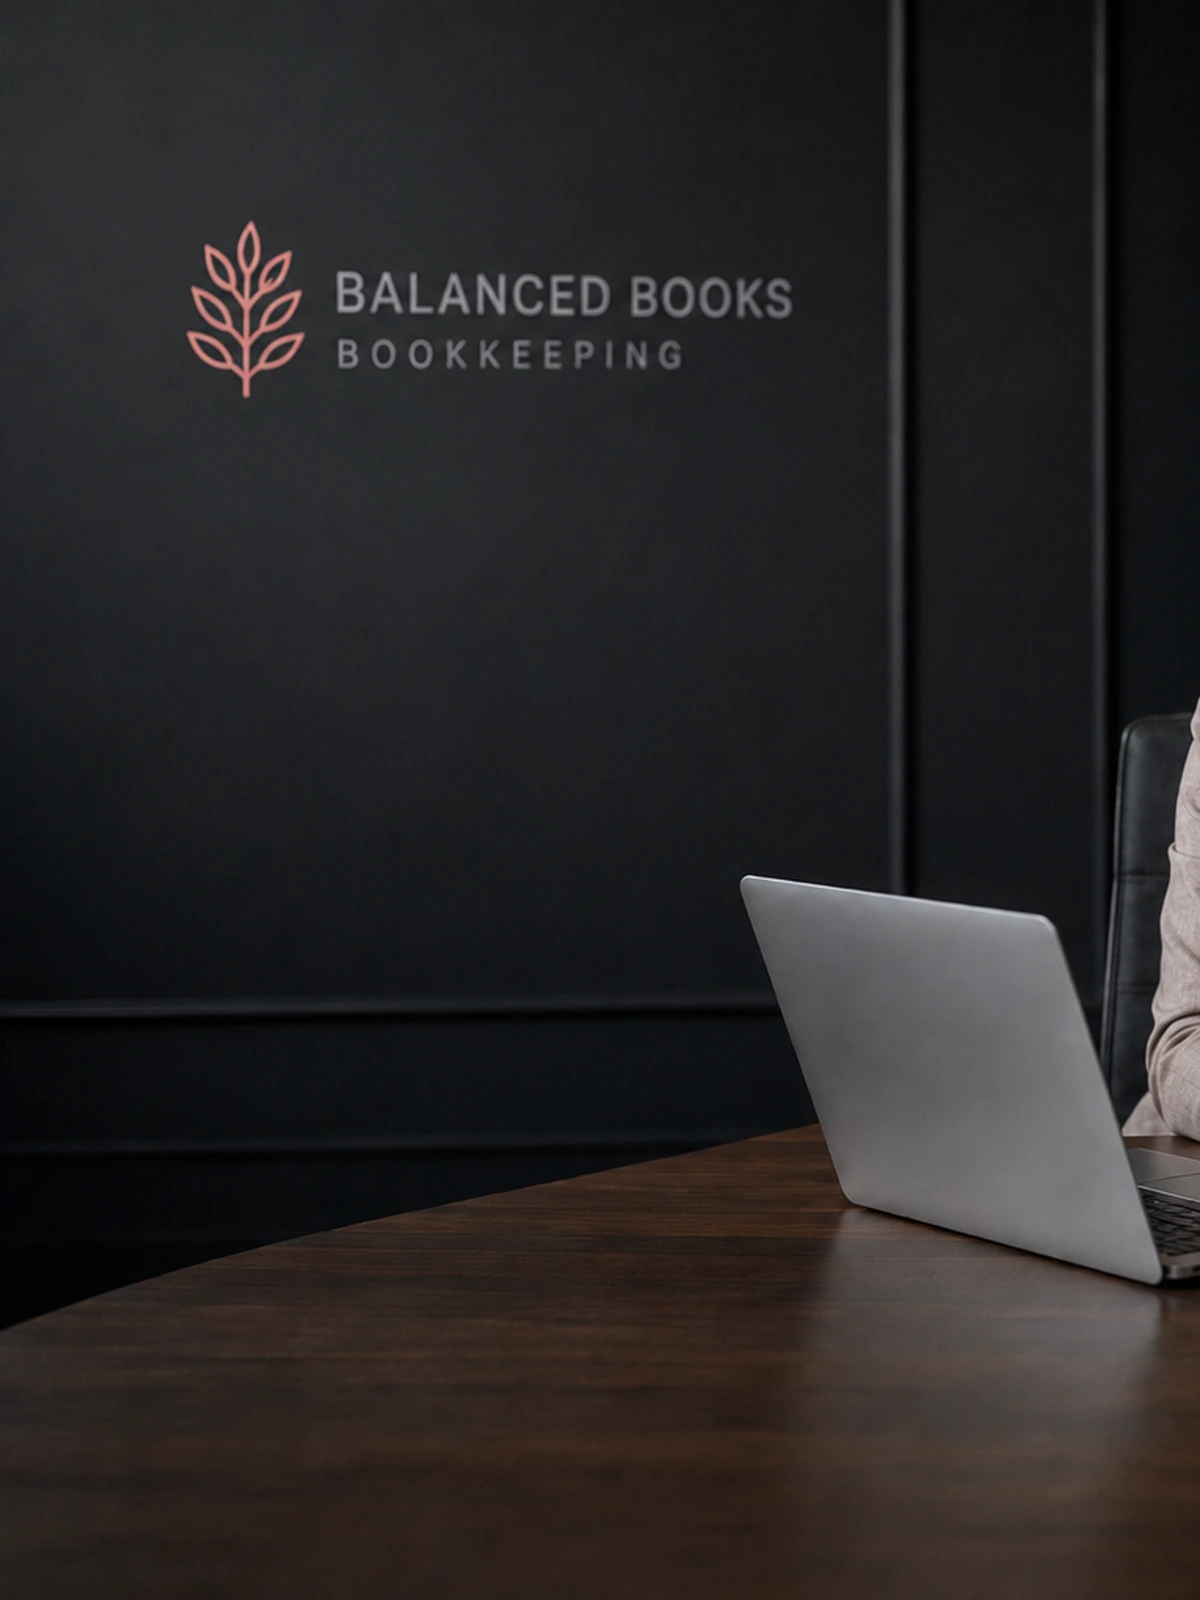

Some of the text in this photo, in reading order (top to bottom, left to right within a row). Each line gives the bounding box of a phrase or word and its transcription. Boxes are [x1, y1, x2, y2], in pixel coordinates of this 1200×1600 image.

[336, 271, 793, 319] BALANCED BOOKS
[337, 339, 682, 370] BOOKKEEPING
